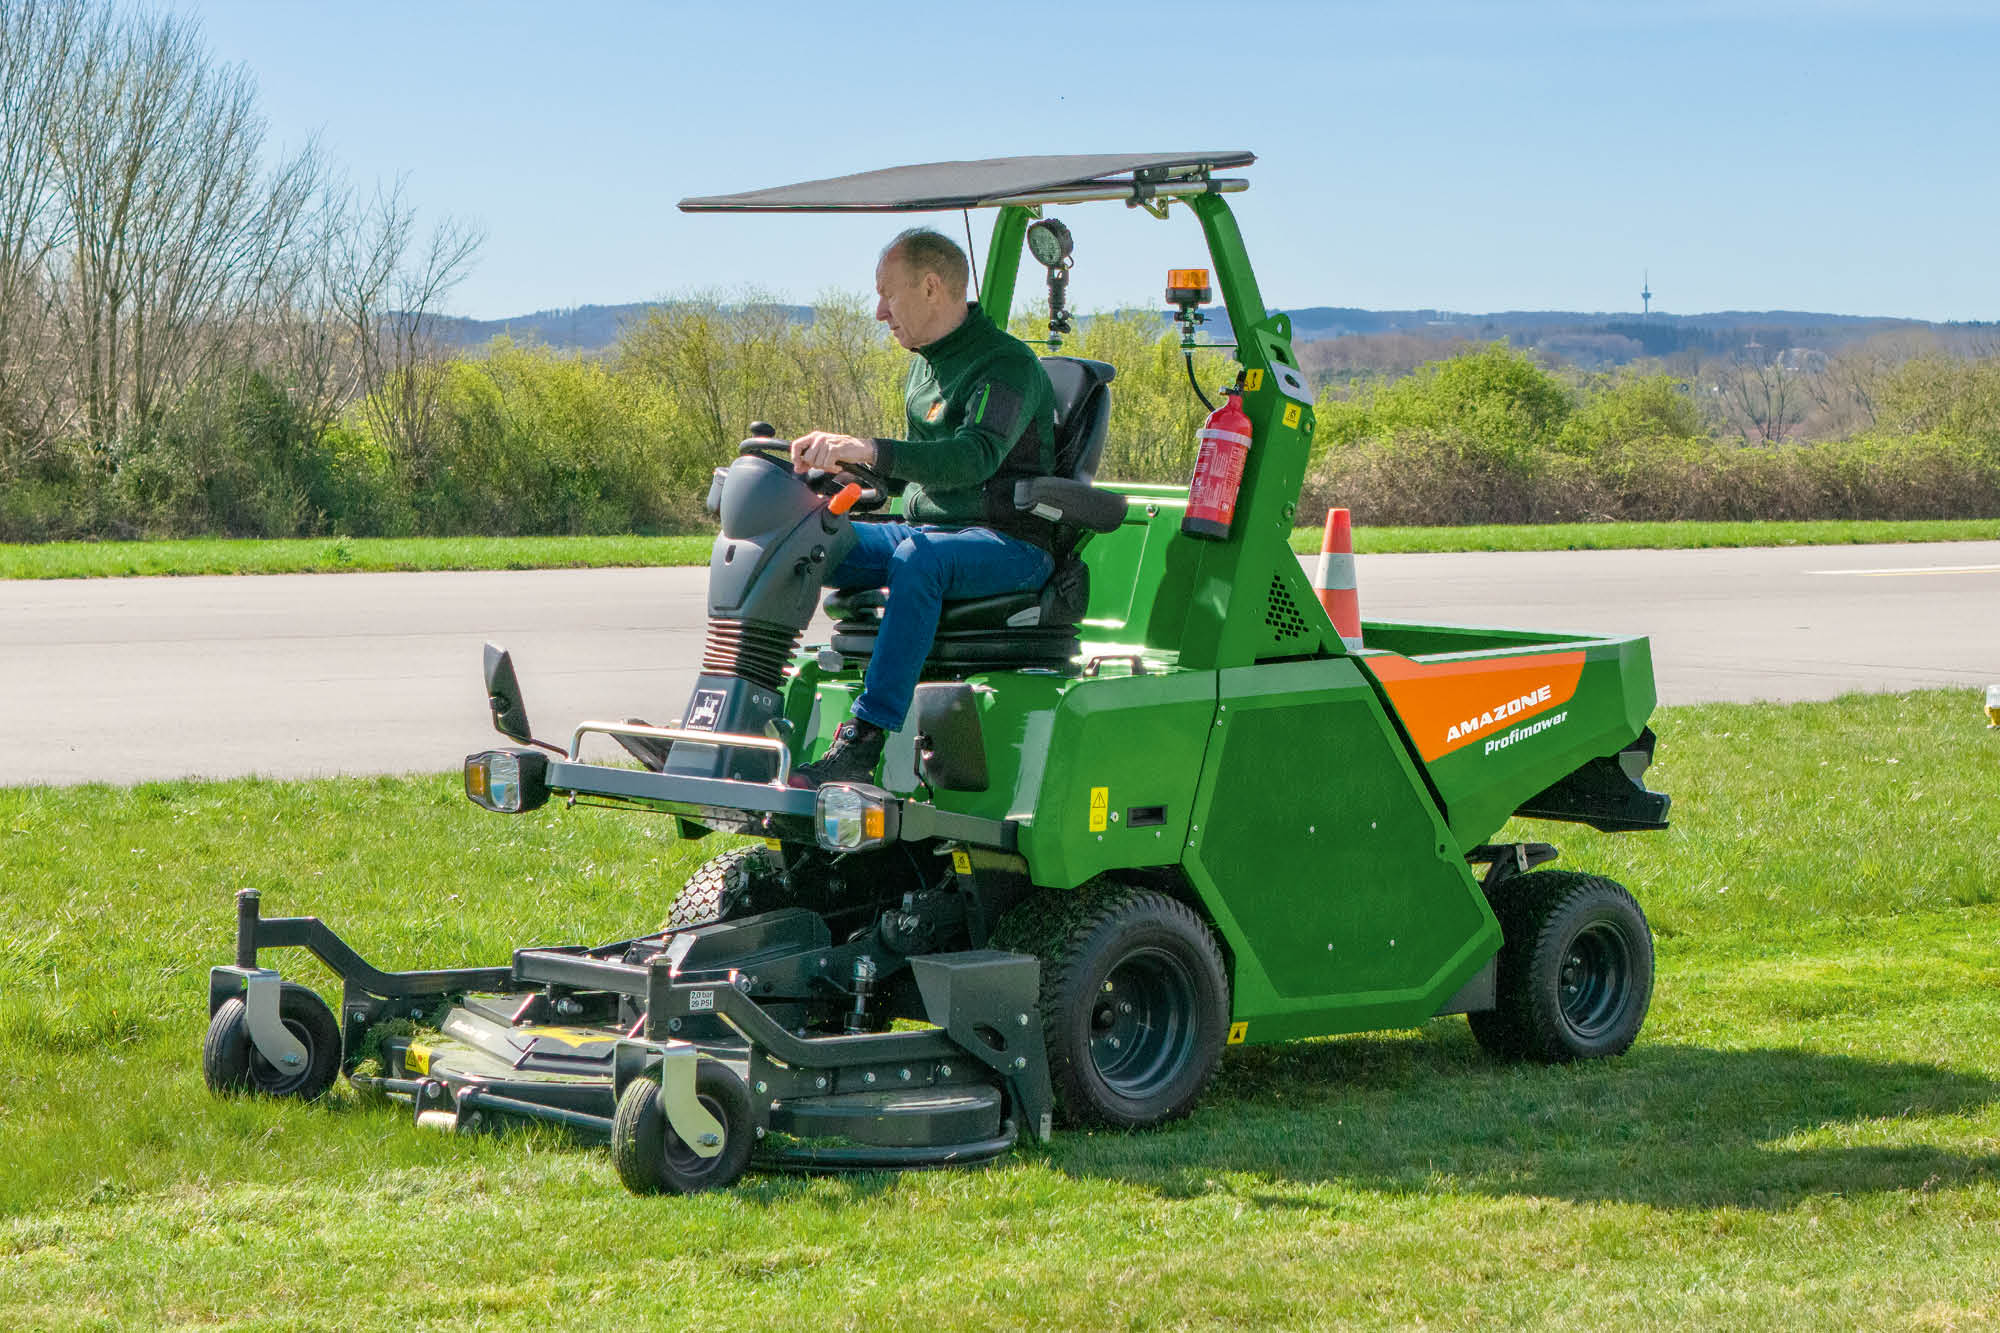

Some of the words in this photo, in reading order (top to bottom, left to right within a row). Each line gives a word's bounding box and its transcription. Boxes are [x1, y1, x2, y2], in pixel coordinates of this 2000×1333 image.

[1447, 685, 1552, 743] AMAZONE
[1484, 711, 1568, 756] Profimower
[700, 999, 712, 1007] PSI
